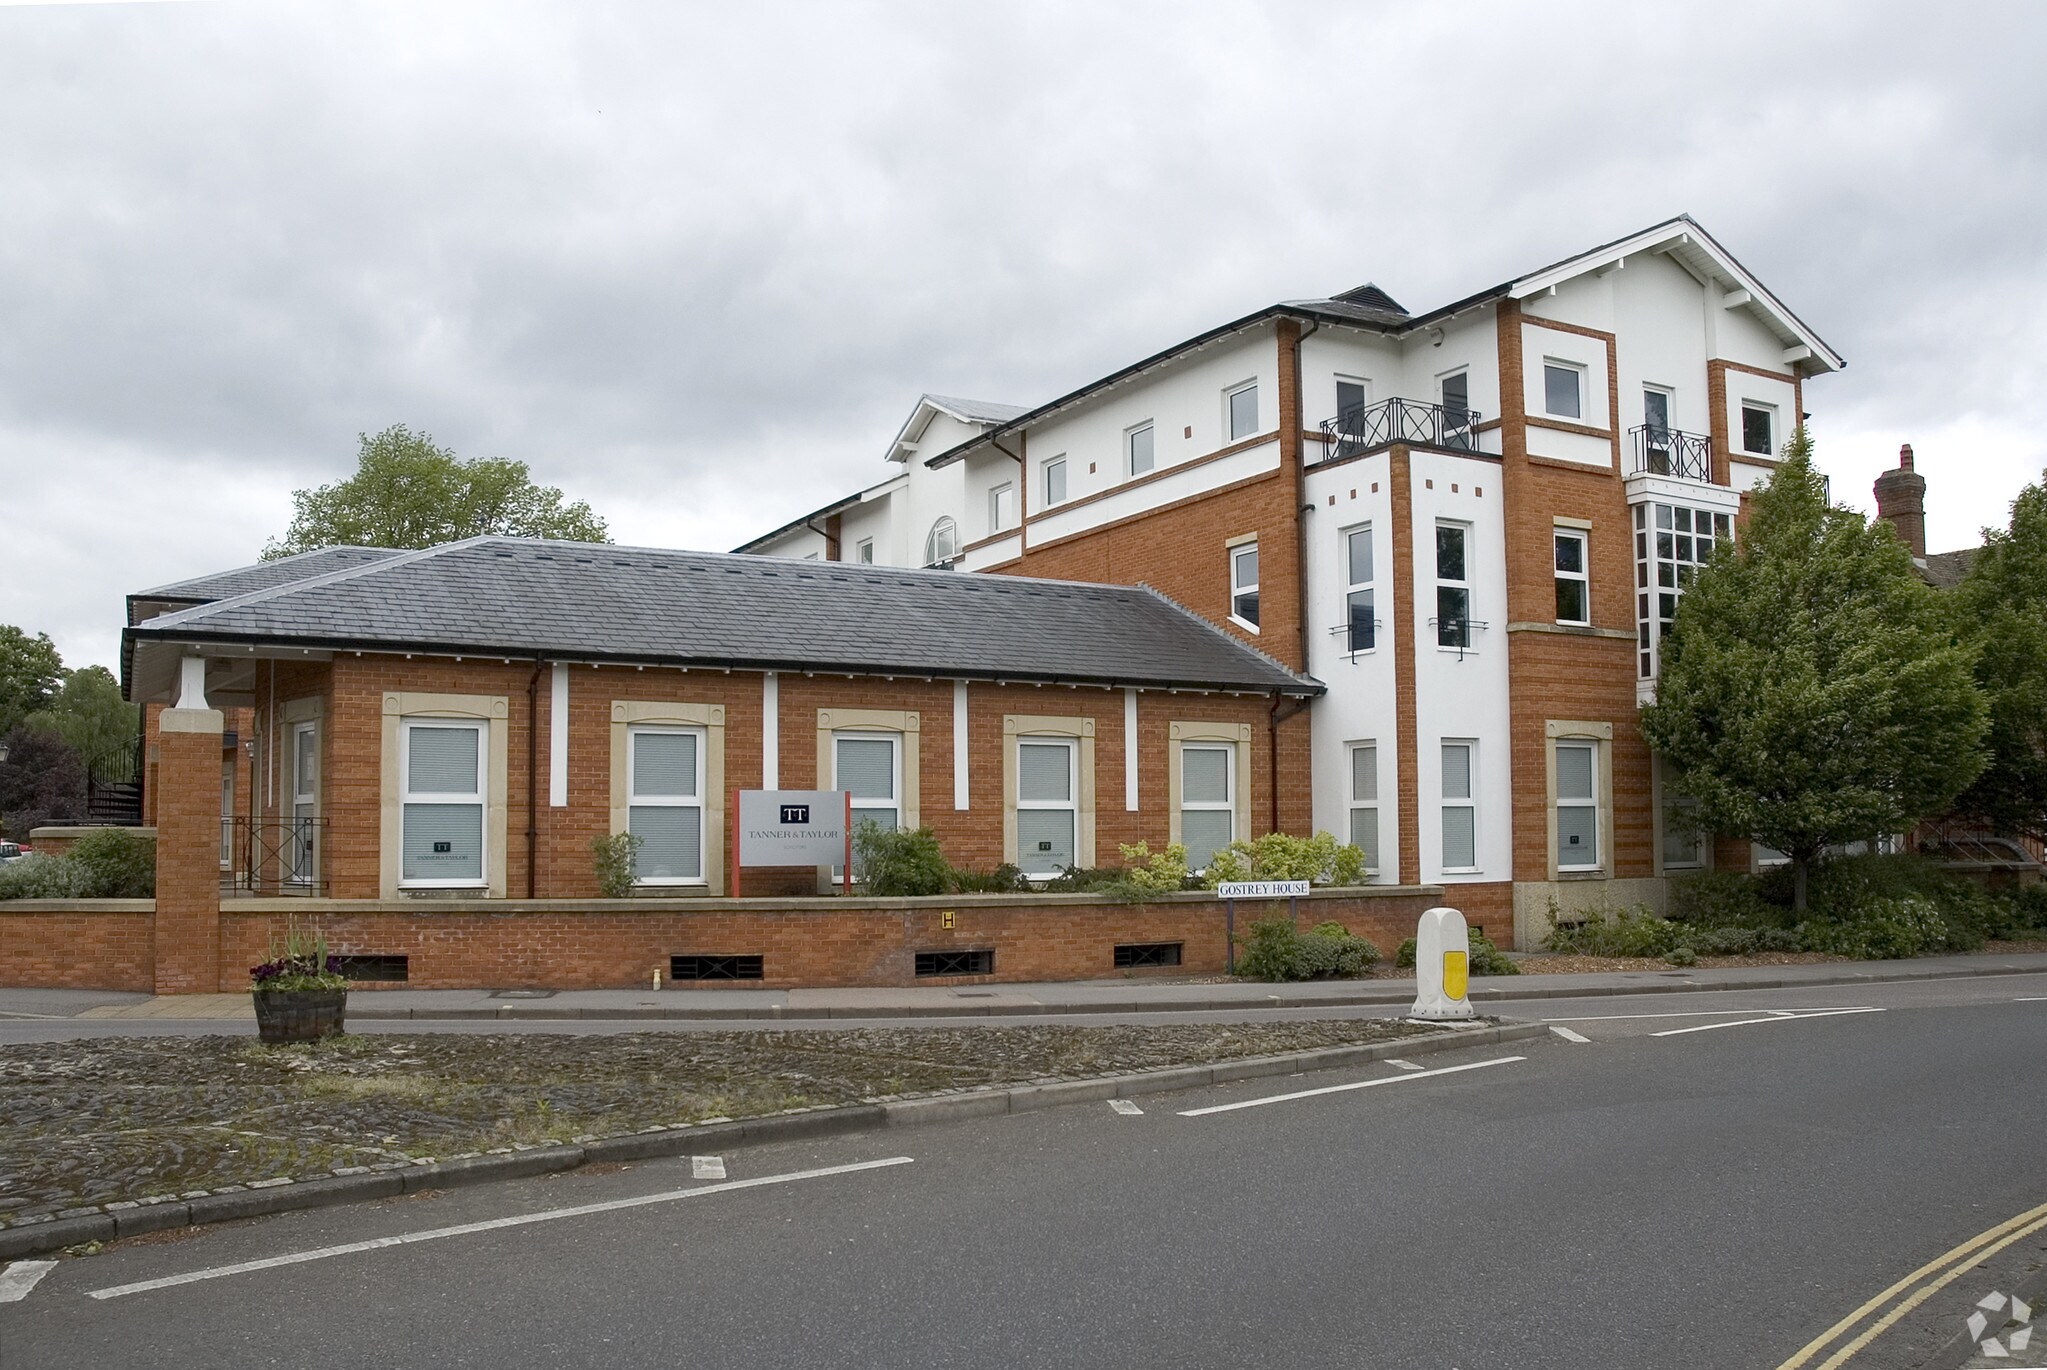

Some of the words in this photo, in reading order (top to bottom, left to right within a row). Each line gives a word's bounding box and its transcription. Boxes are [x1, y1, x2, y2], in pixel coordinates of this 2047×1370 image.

[783, 808, 807, 821] TT
[748, 830, 791, 839] TANNER
[792, 831, 799, 839] &
[799, 830, 838, 839] TAYLOR
[1219, 884, 1269, 896] GOSTREY
[1272, 883, 1308, 895] HOUSE
